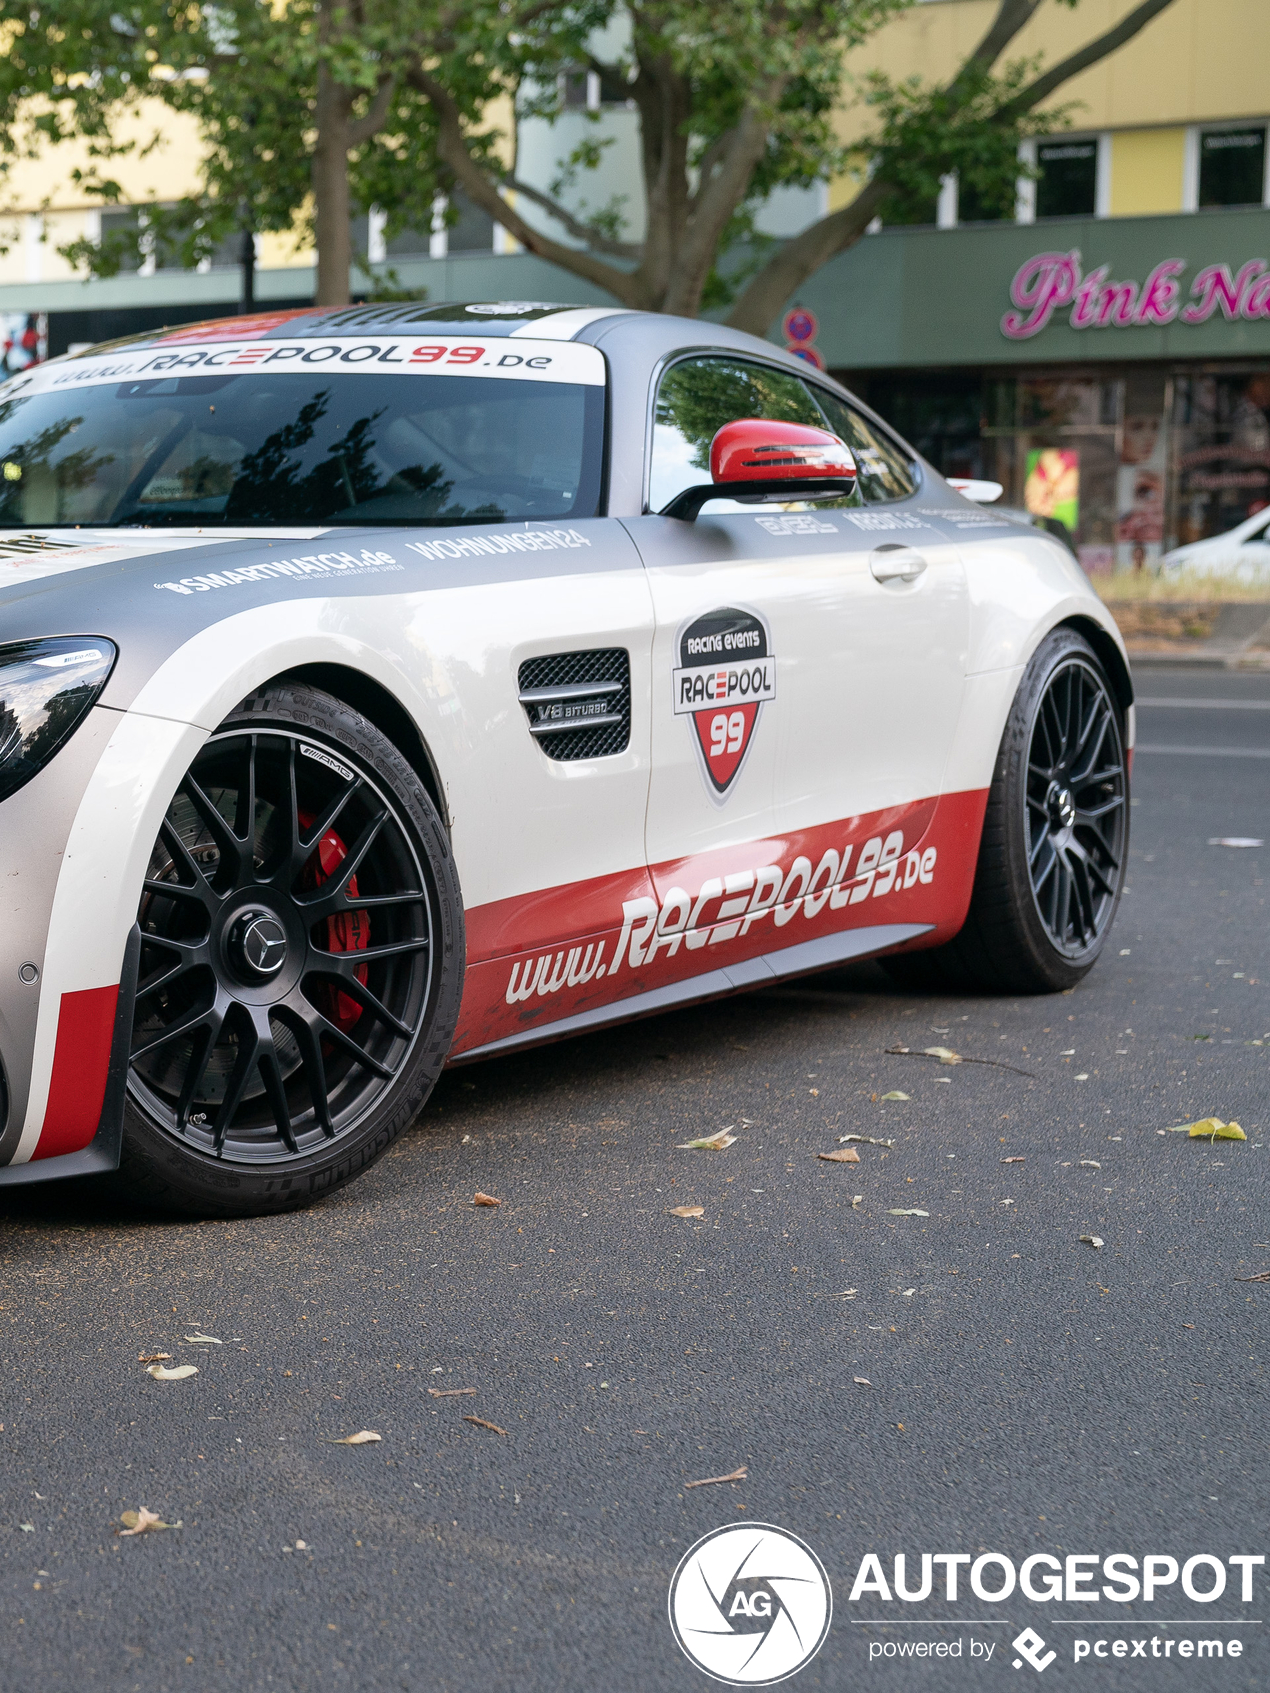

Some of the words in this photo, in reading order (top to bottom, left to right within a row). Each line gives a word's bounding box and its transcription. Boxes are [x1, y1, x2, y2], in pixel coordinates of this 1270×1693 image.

[1000, 247, 1187, 340] Pink
[405, 528, 592, 562] WOHNUNGEN24
[182, 549, 397, 593] SMARTWATCH.de
[687, 634, 723, 656] RACING
[680, 665, 772, 705] RACEPOOL
[537, 704, 564, 721] V8
[564, 702, 607, 718] BITURBO
[709, 711, 746, 757] 99
[320, 755, 351, 779] AMG
[313, 1102, 413, 1191] MICHELIN
